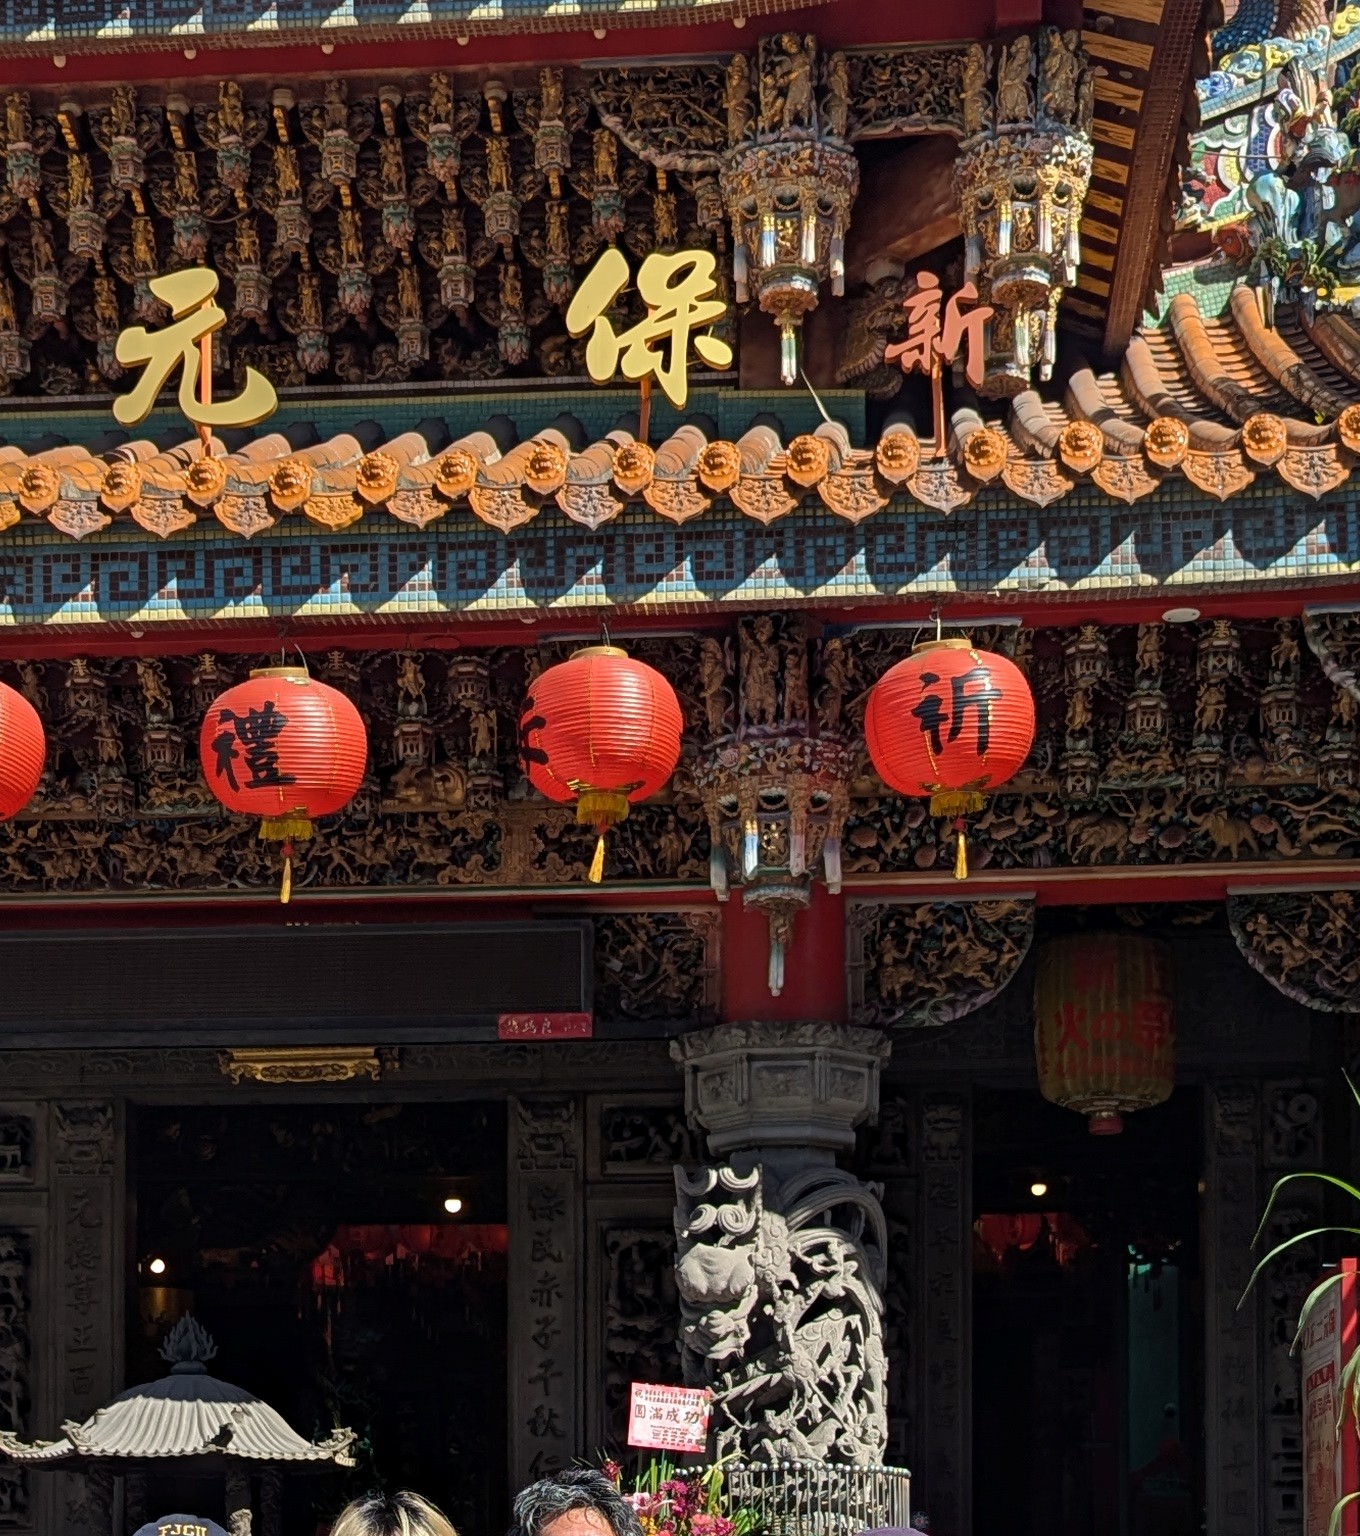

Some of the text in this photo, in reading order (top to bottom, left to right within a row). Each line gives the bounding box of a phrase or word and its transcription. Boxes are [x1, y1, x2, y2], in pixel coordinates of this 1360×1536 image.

[885, 271, 994, 388] 新
[210, 702, 296, 793] 禮
[912, 671, 1003, 757] 祈
